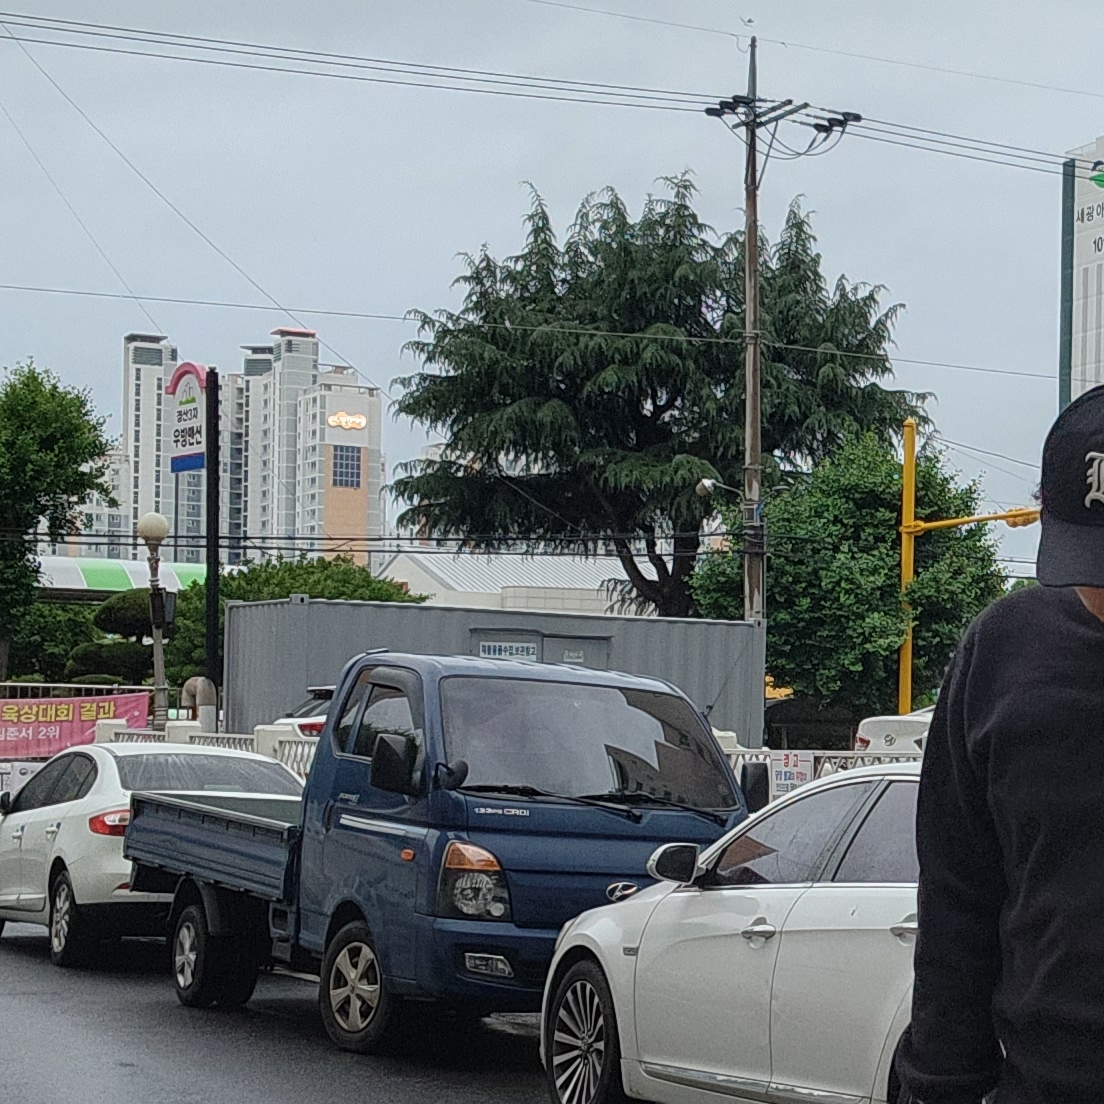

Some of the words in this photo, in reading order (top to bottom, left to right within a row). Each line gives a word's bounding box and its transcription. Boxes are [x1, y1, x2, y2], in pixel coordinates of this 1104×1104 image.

[1, 703, 74, 722] 육상대회
[80, 701, 116, 721] 결과
[37, 725, 60, 739] 2위
